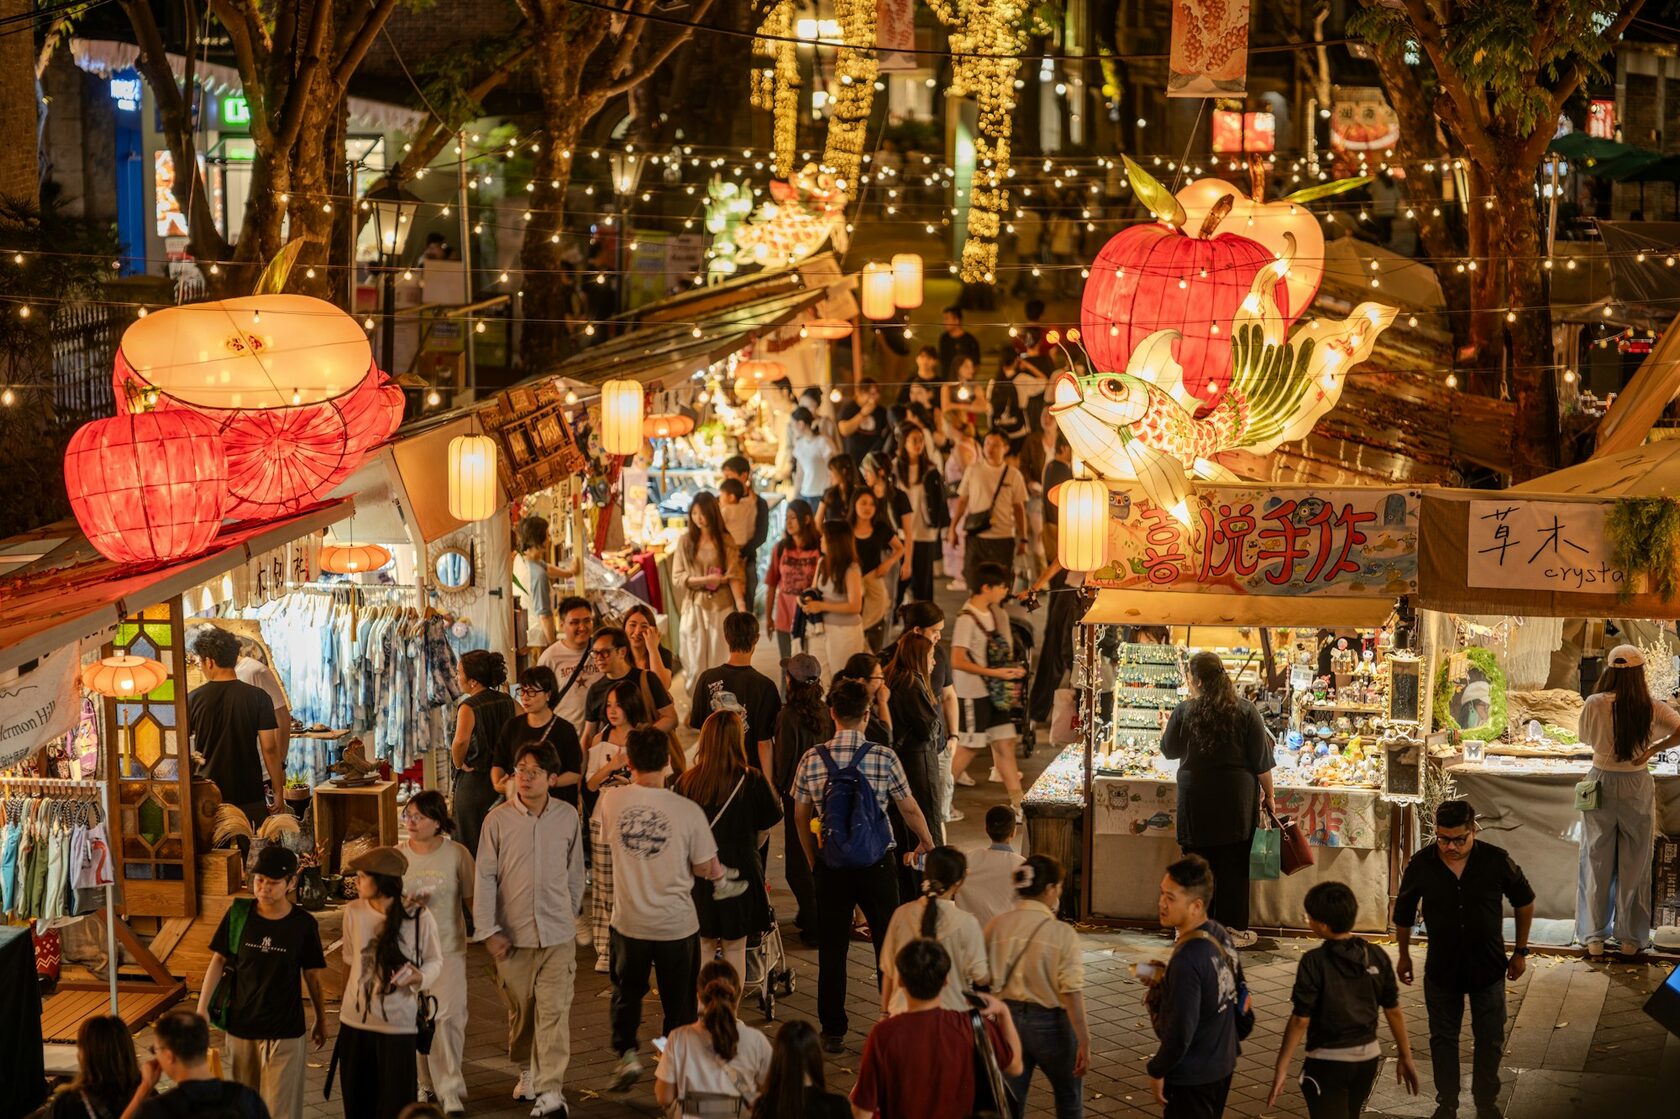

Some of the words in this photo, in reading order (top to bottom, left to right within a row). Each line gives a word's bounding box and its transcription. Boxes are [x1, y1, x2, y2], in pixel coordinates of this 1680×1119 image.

[1140, 496, 1378, 586] 喜悦手作
[1478, 507, 1590, 566] 草木
[1544, 561, 1626, 589] crysta
[36, 700, 57, 725] Hill
